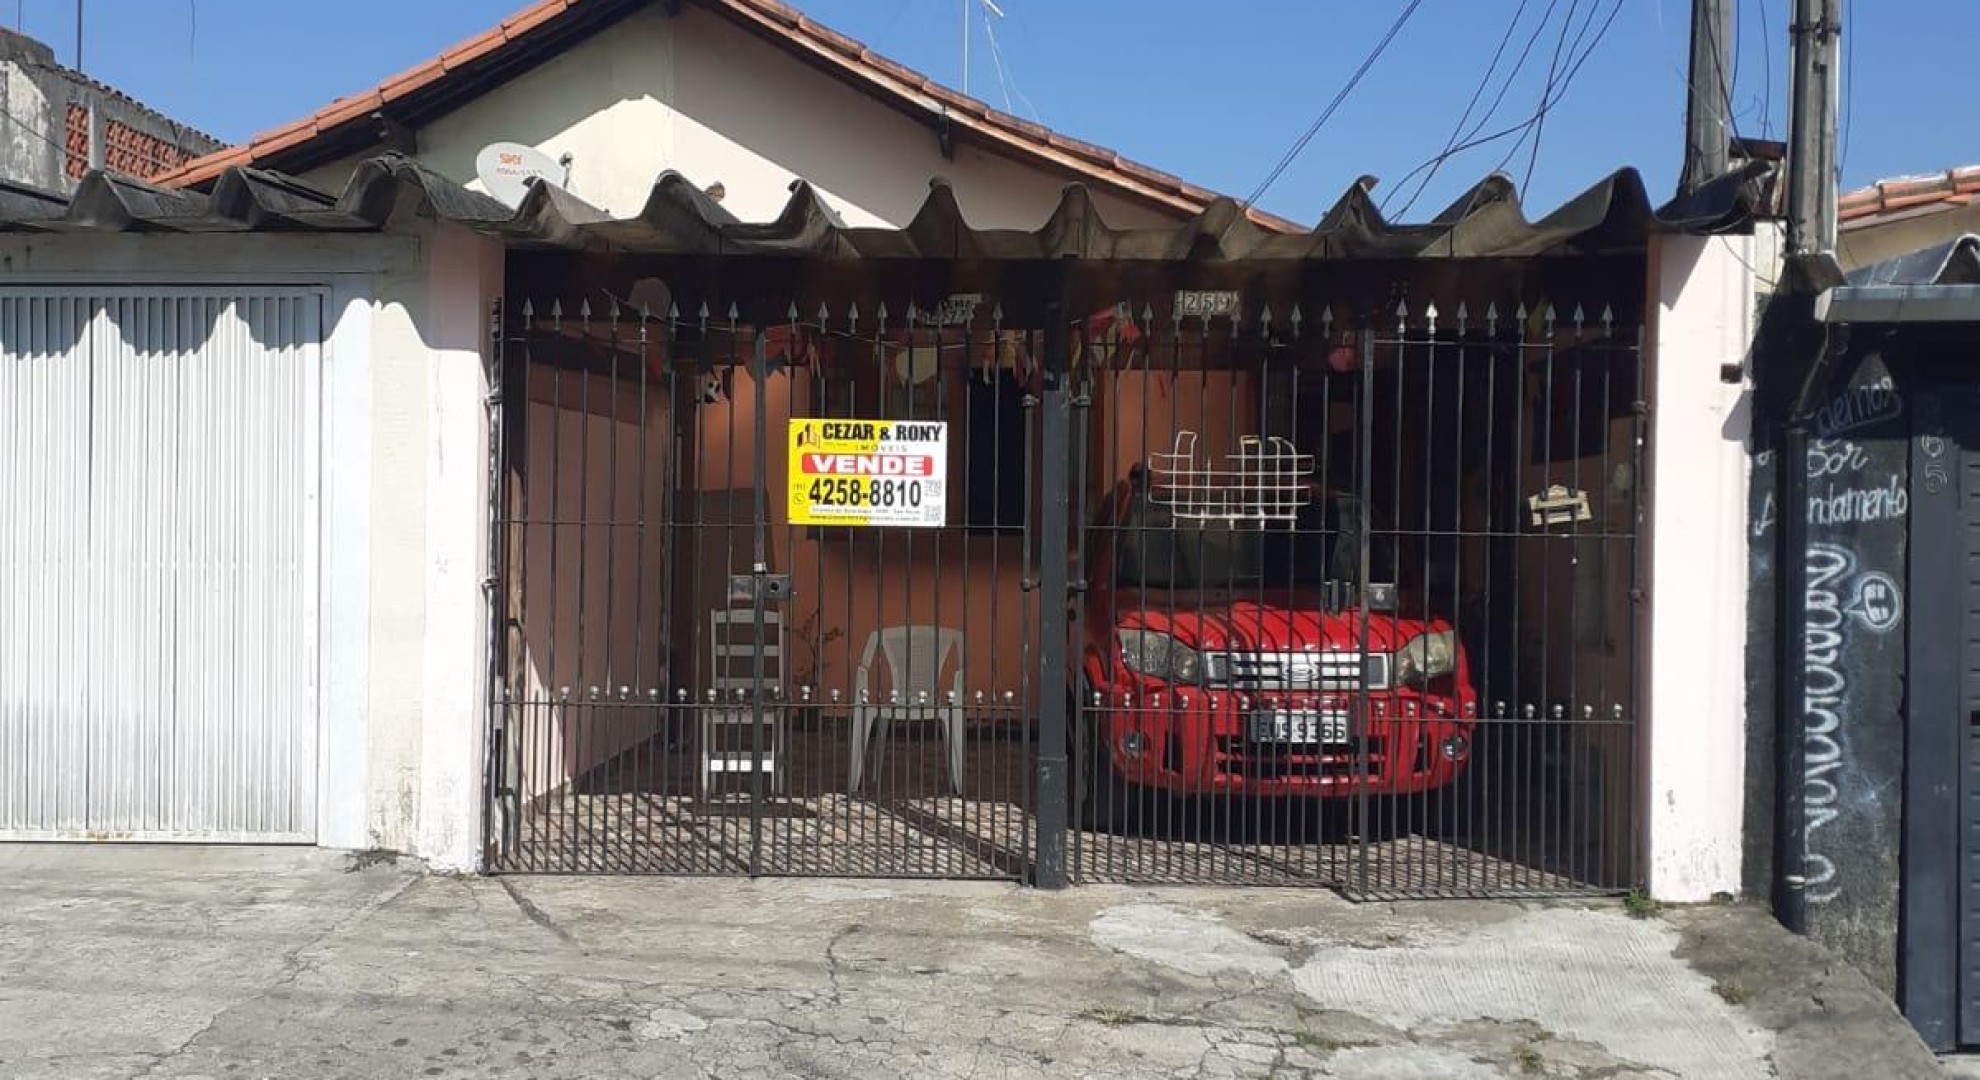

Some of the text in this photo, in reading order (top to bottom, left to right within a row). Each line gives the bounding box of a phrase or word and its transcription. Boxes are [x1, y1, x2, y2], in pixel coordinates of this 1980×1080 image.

[822, 423, 943, 442] CEZAR & RONY
[811, 455, 925, 474] VENDE
[809, 478, 922, 507] 4258-8810
